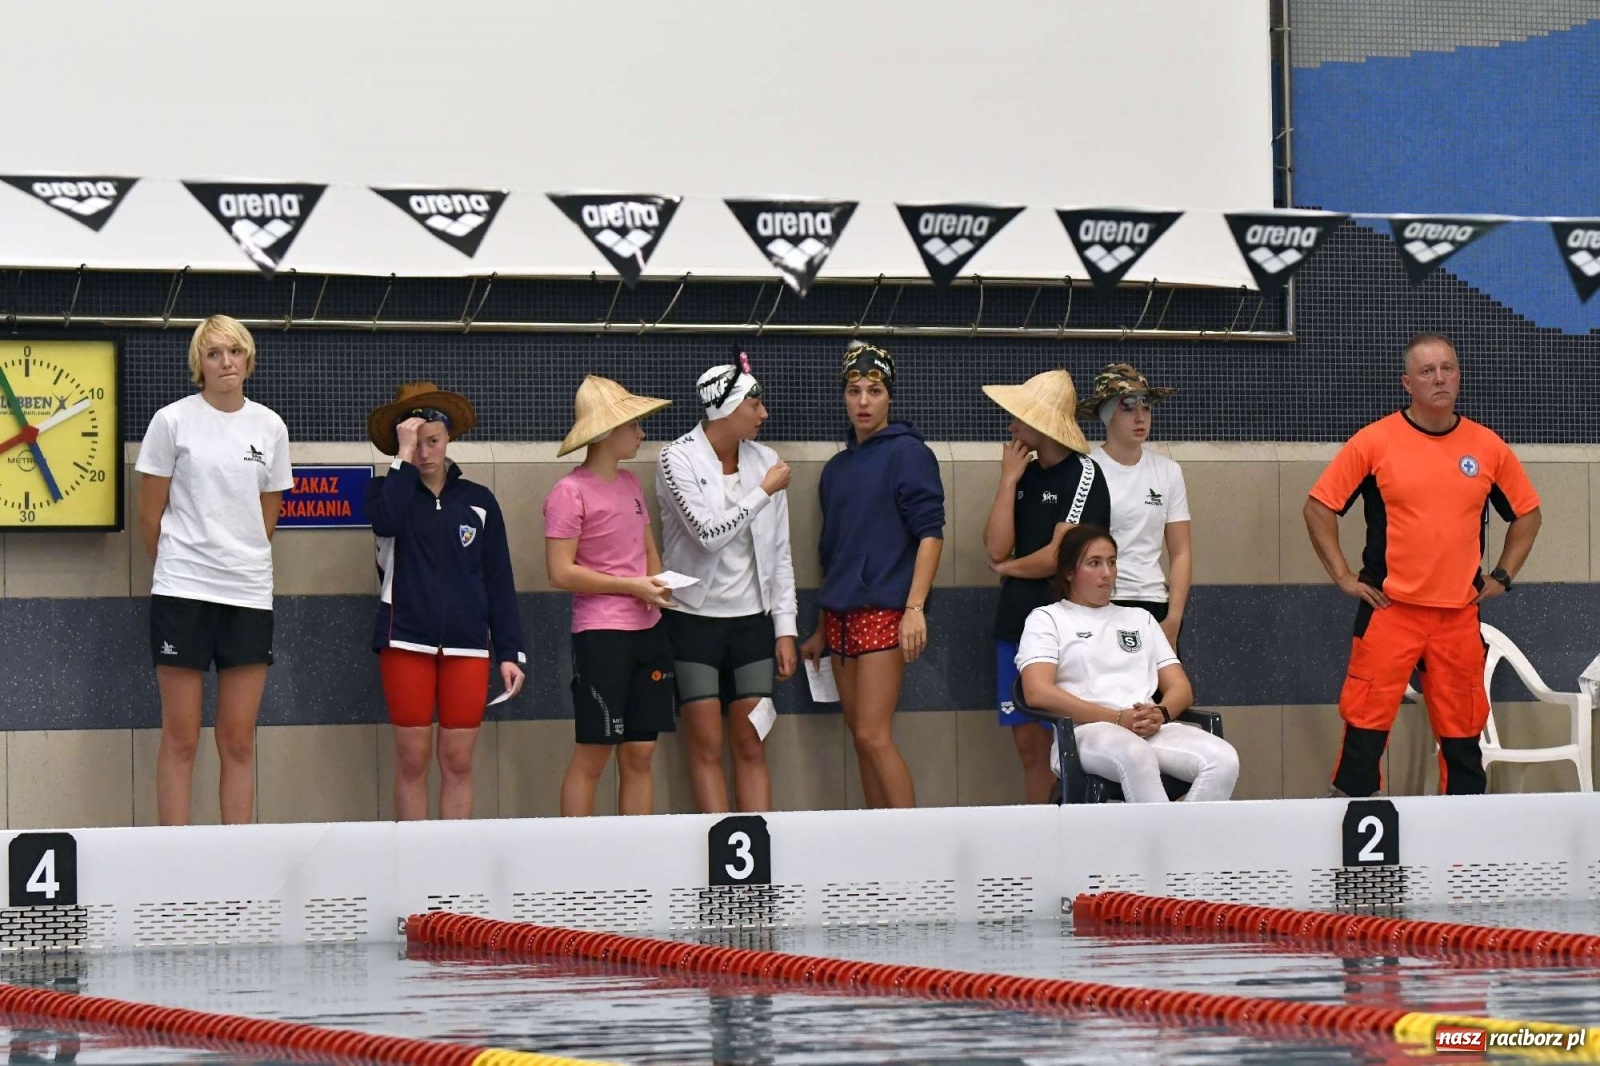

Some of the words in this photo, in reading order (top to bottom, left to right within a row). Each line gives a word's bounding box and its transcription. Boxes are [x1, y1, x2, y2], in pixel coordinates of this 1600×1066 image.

[32, 181, 117, 197] arena
[218, 193, 300, 218] arena
[408, 194, 490, 215] arena
[582, 202, 659, 228] arena
[756, 212, 832, 237] arena
[918, 212, 990, 237] arena
[1078, 218, 1150, 244] arena
[1403, 222, 1474, 241] arena
[1245, 224, 1319, 248] arena
[23, 346, 32, 358] 0
[88, 387, 104, 400] 10
[89, 470, 105, 482] 20
[291, 477, 339, 493] ZAKAZ
[19, 510, 36, 523] 30
[279, 500, 352, 517] SKAKANIA
[1357, 815, 1384, 861] 2
[725, 831, 754, 880] 3
[26, 849, 60, 899] 4
